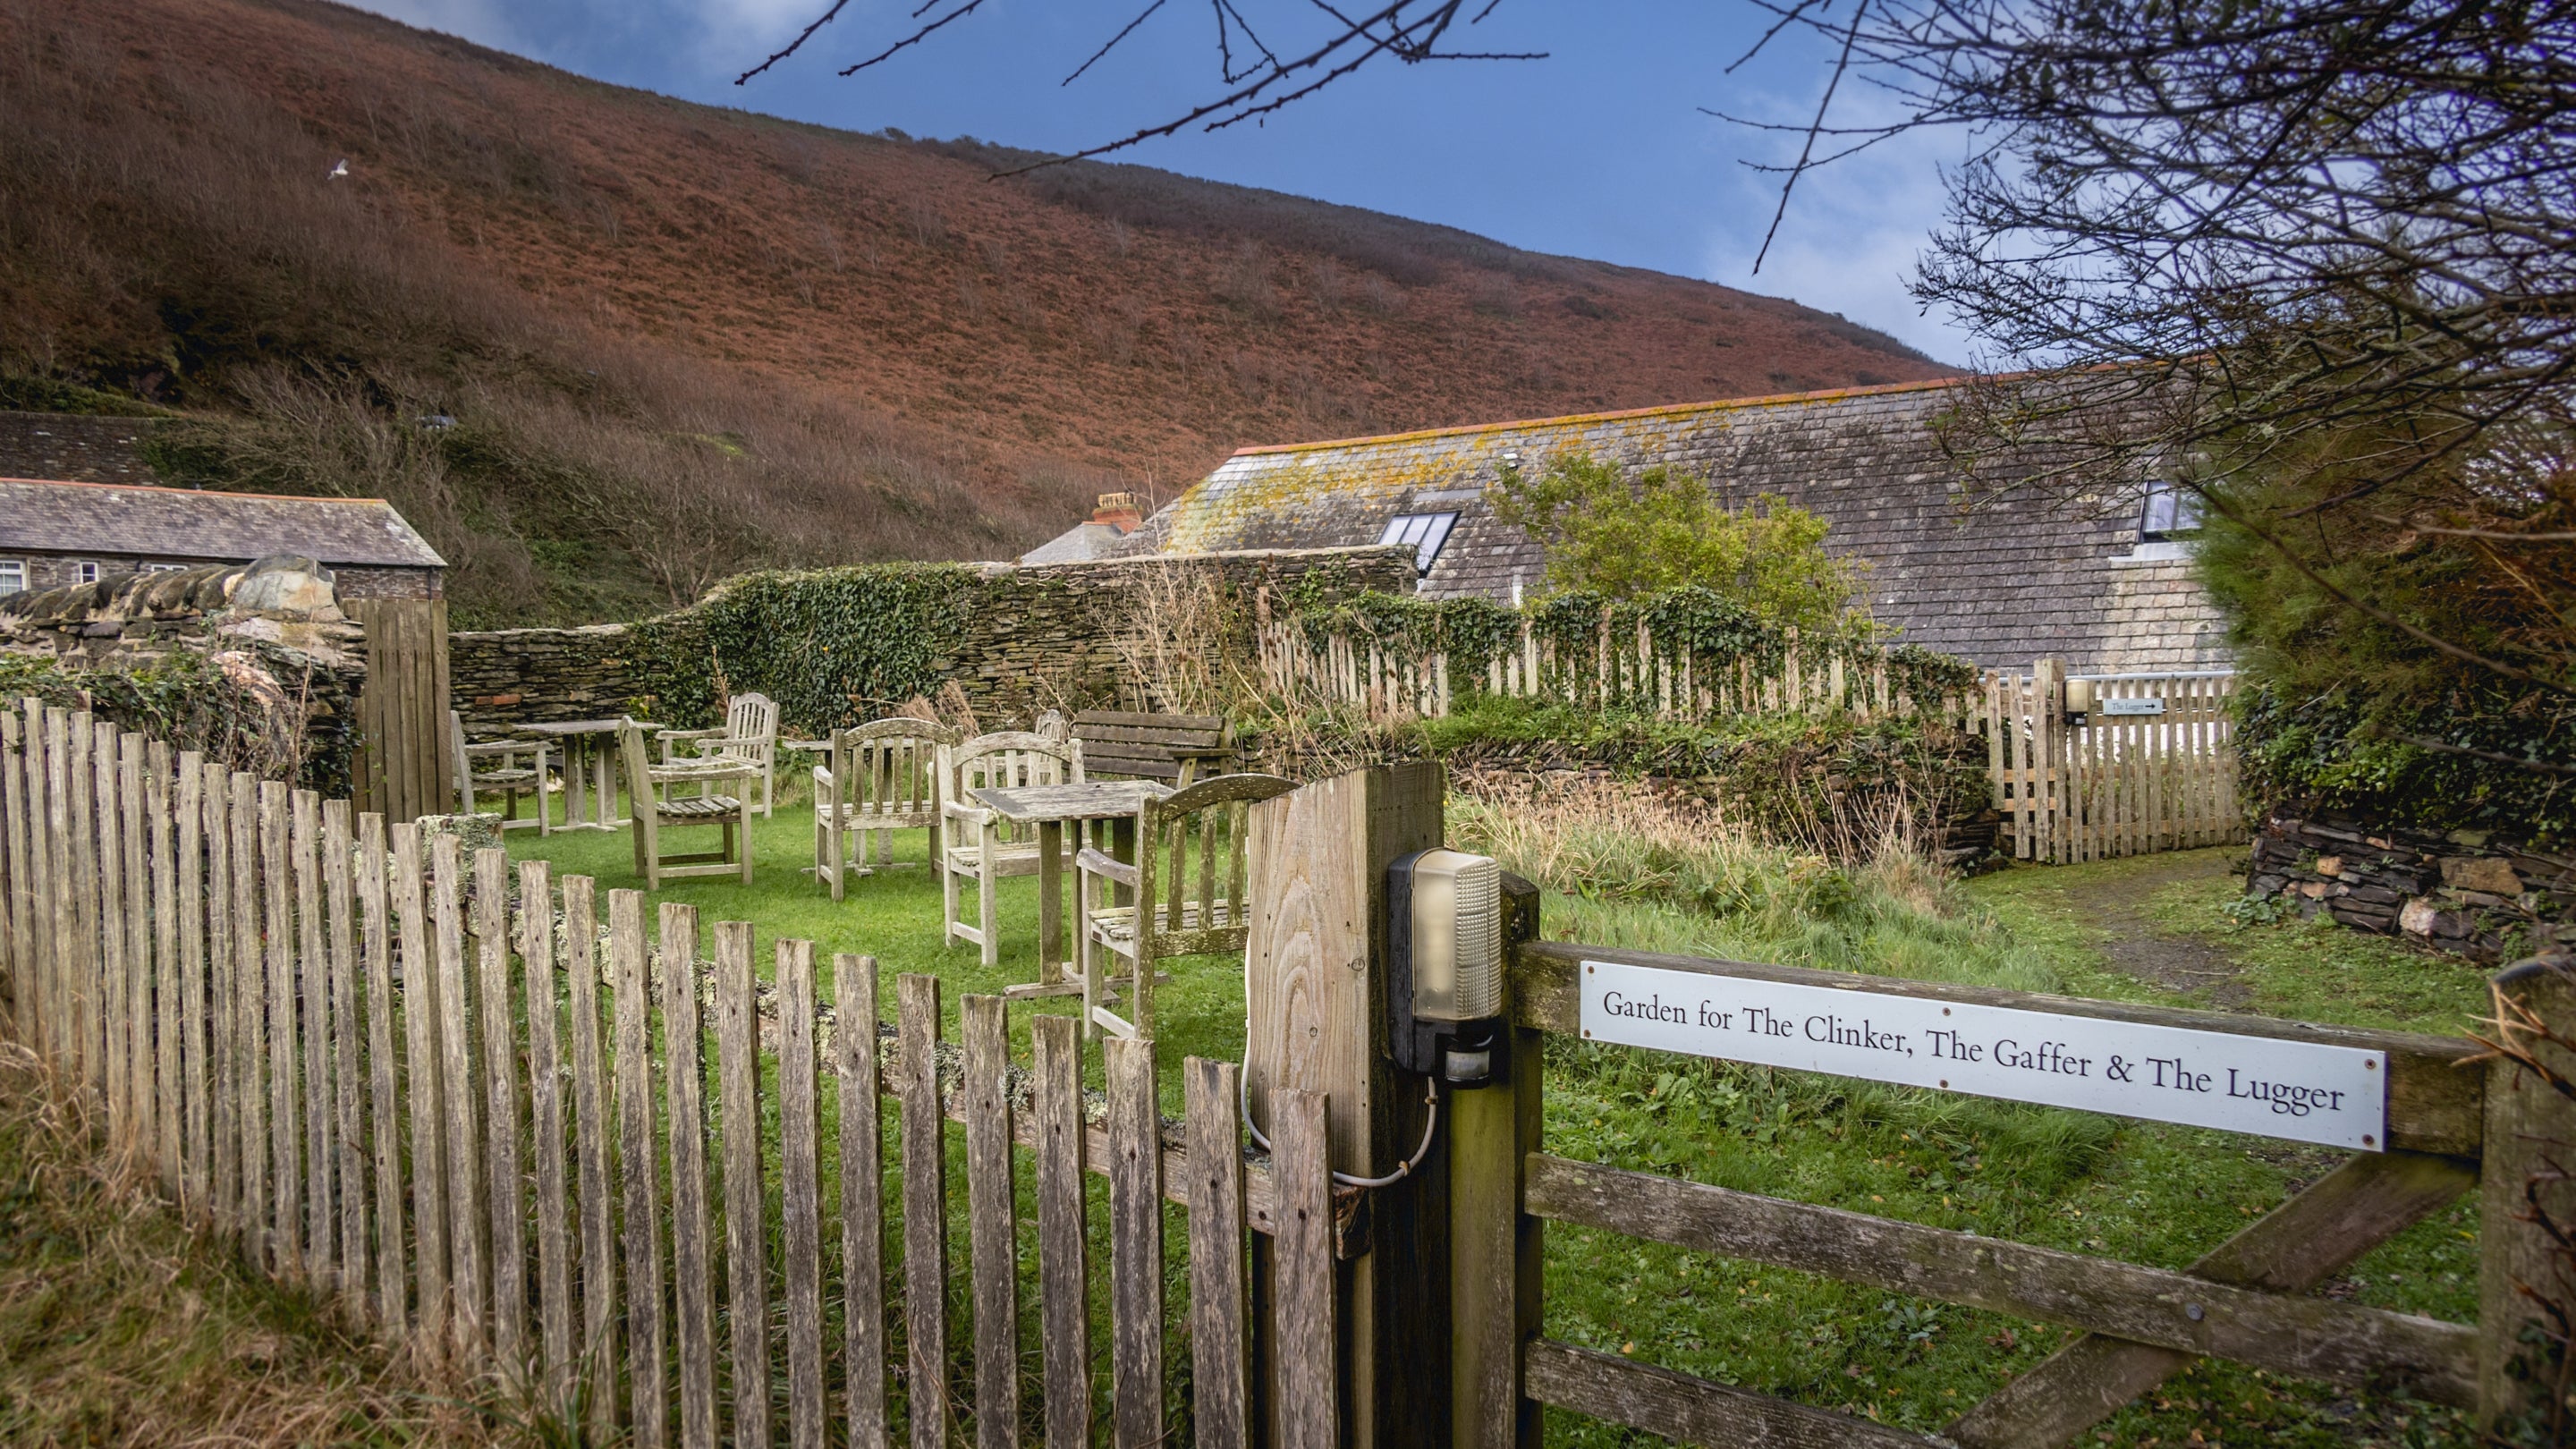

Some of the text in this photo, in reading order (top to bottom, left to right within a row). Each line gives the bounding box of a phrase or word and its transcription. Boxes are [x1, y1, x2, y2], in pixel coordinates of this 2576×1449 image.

[2112, 702, 2123, 710] The
[1603, 991, 2346, 1117] Garden for The Clinker, The Gaffer & The Lugger
